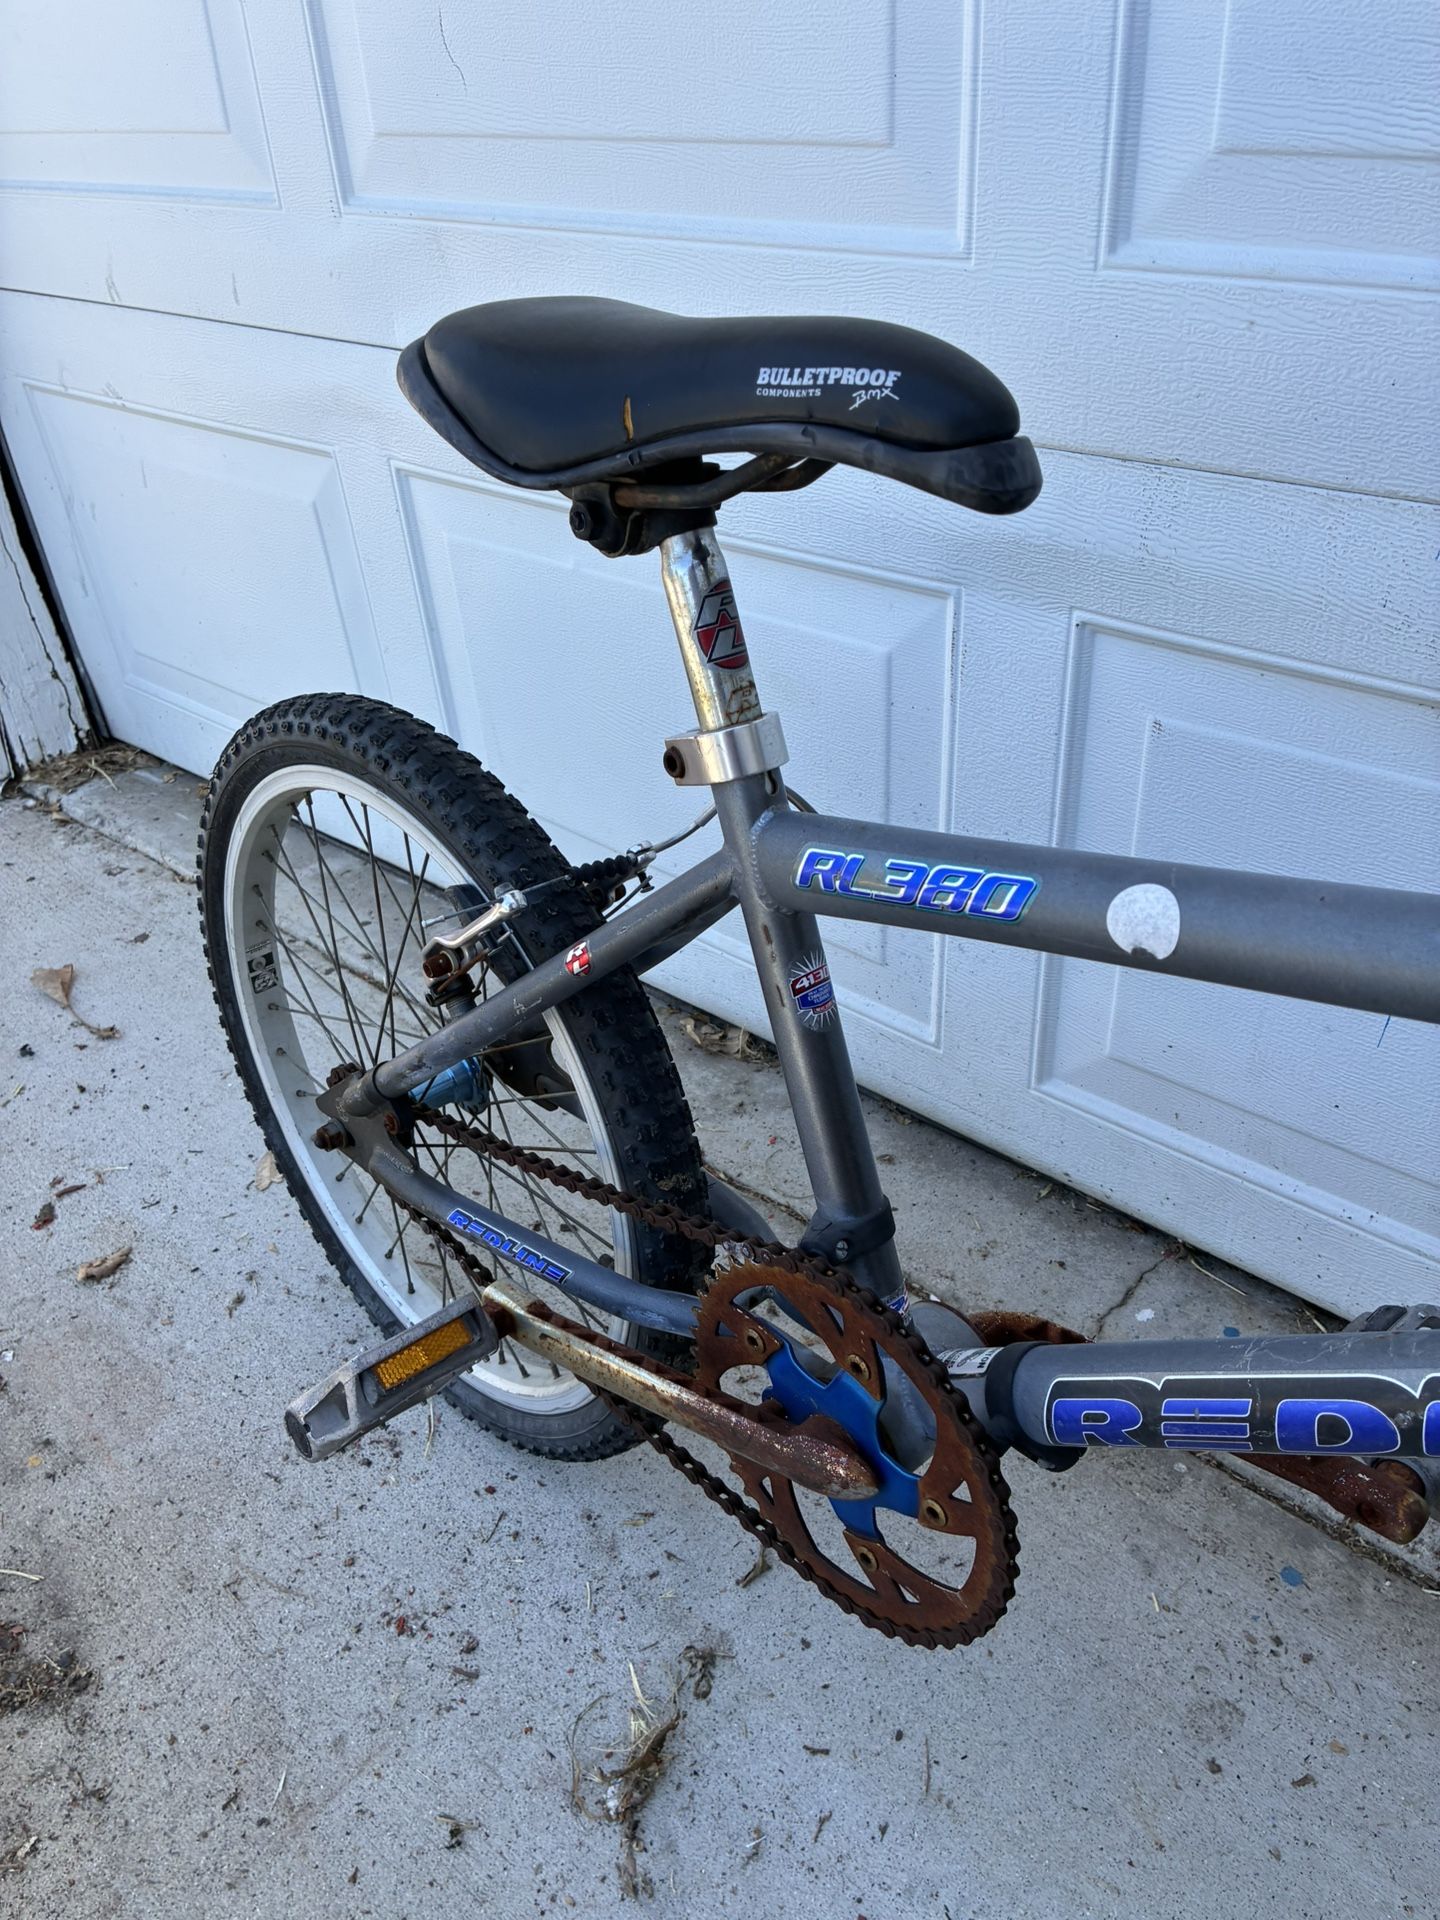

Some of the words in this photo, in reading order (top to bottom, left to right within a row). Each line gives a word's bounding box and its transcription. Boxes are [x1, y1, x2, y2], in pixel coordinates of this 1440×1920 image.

[756, 367, 902, 387] BULLETPROOF
[756, 388, 822, 397] COMPONENTS
[849, 387, 900, 410] BMX
[796, 848, 1038, 922] RL380
[447, 1208, 572, 1284] REDLINE
